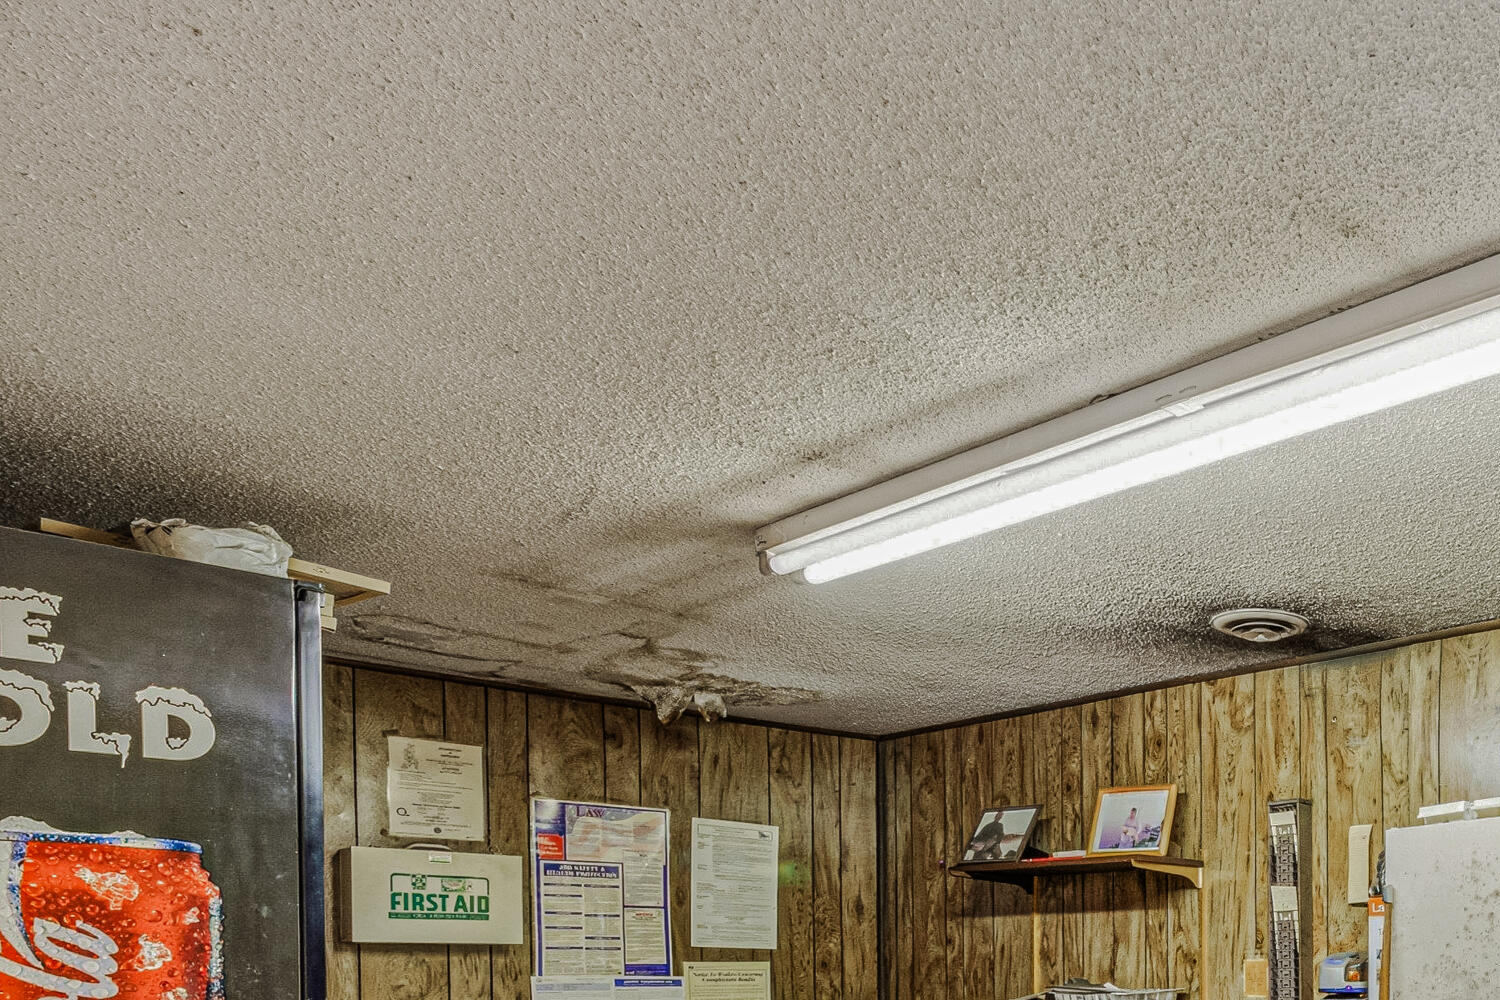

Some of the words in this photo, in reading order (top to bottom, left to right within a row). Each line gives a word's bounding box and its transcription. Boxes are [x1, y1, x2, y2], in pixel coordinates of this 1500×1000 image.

[576, 806, 605, 818] LAW
[390, 891, 449, 912] FIRST
[454, 895, 489, 913] AID
